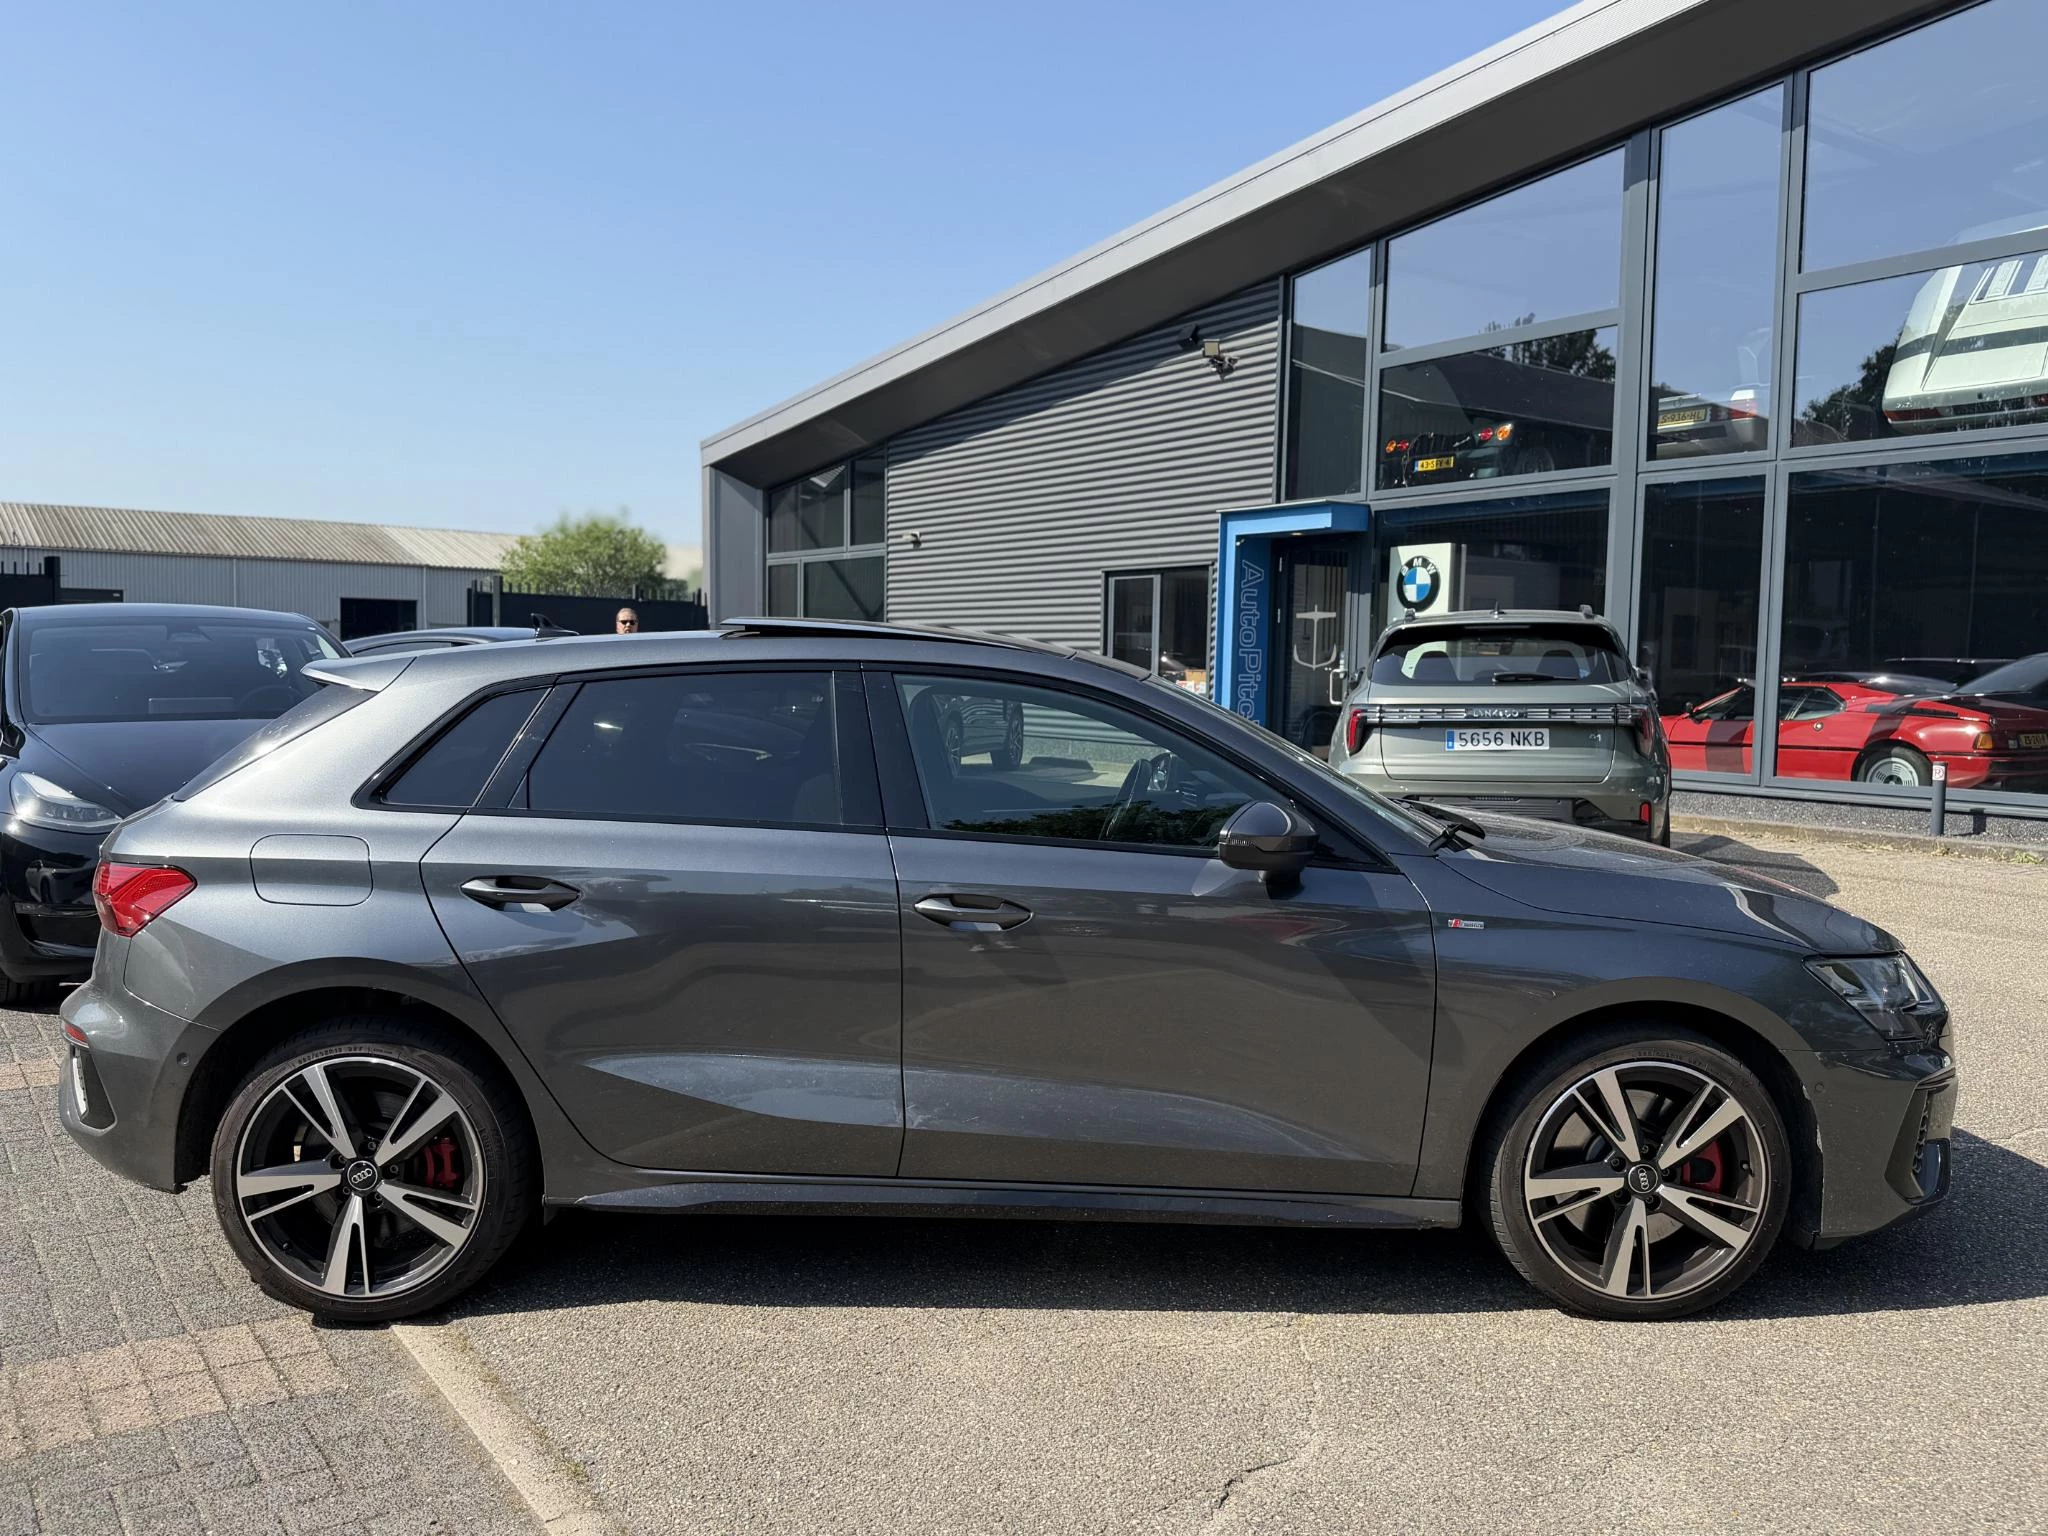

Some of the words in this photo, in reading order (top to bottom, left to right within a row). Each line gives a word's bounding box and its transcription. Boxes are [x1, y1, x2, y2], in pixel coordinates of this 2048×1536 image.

[1400, 557, 1437, 577] BMW
[1238, 559, 1265, 727] AutoPitc
[1458, 732, 1504, 747] 5656
[1510, 731, 1545, 747] NKB
